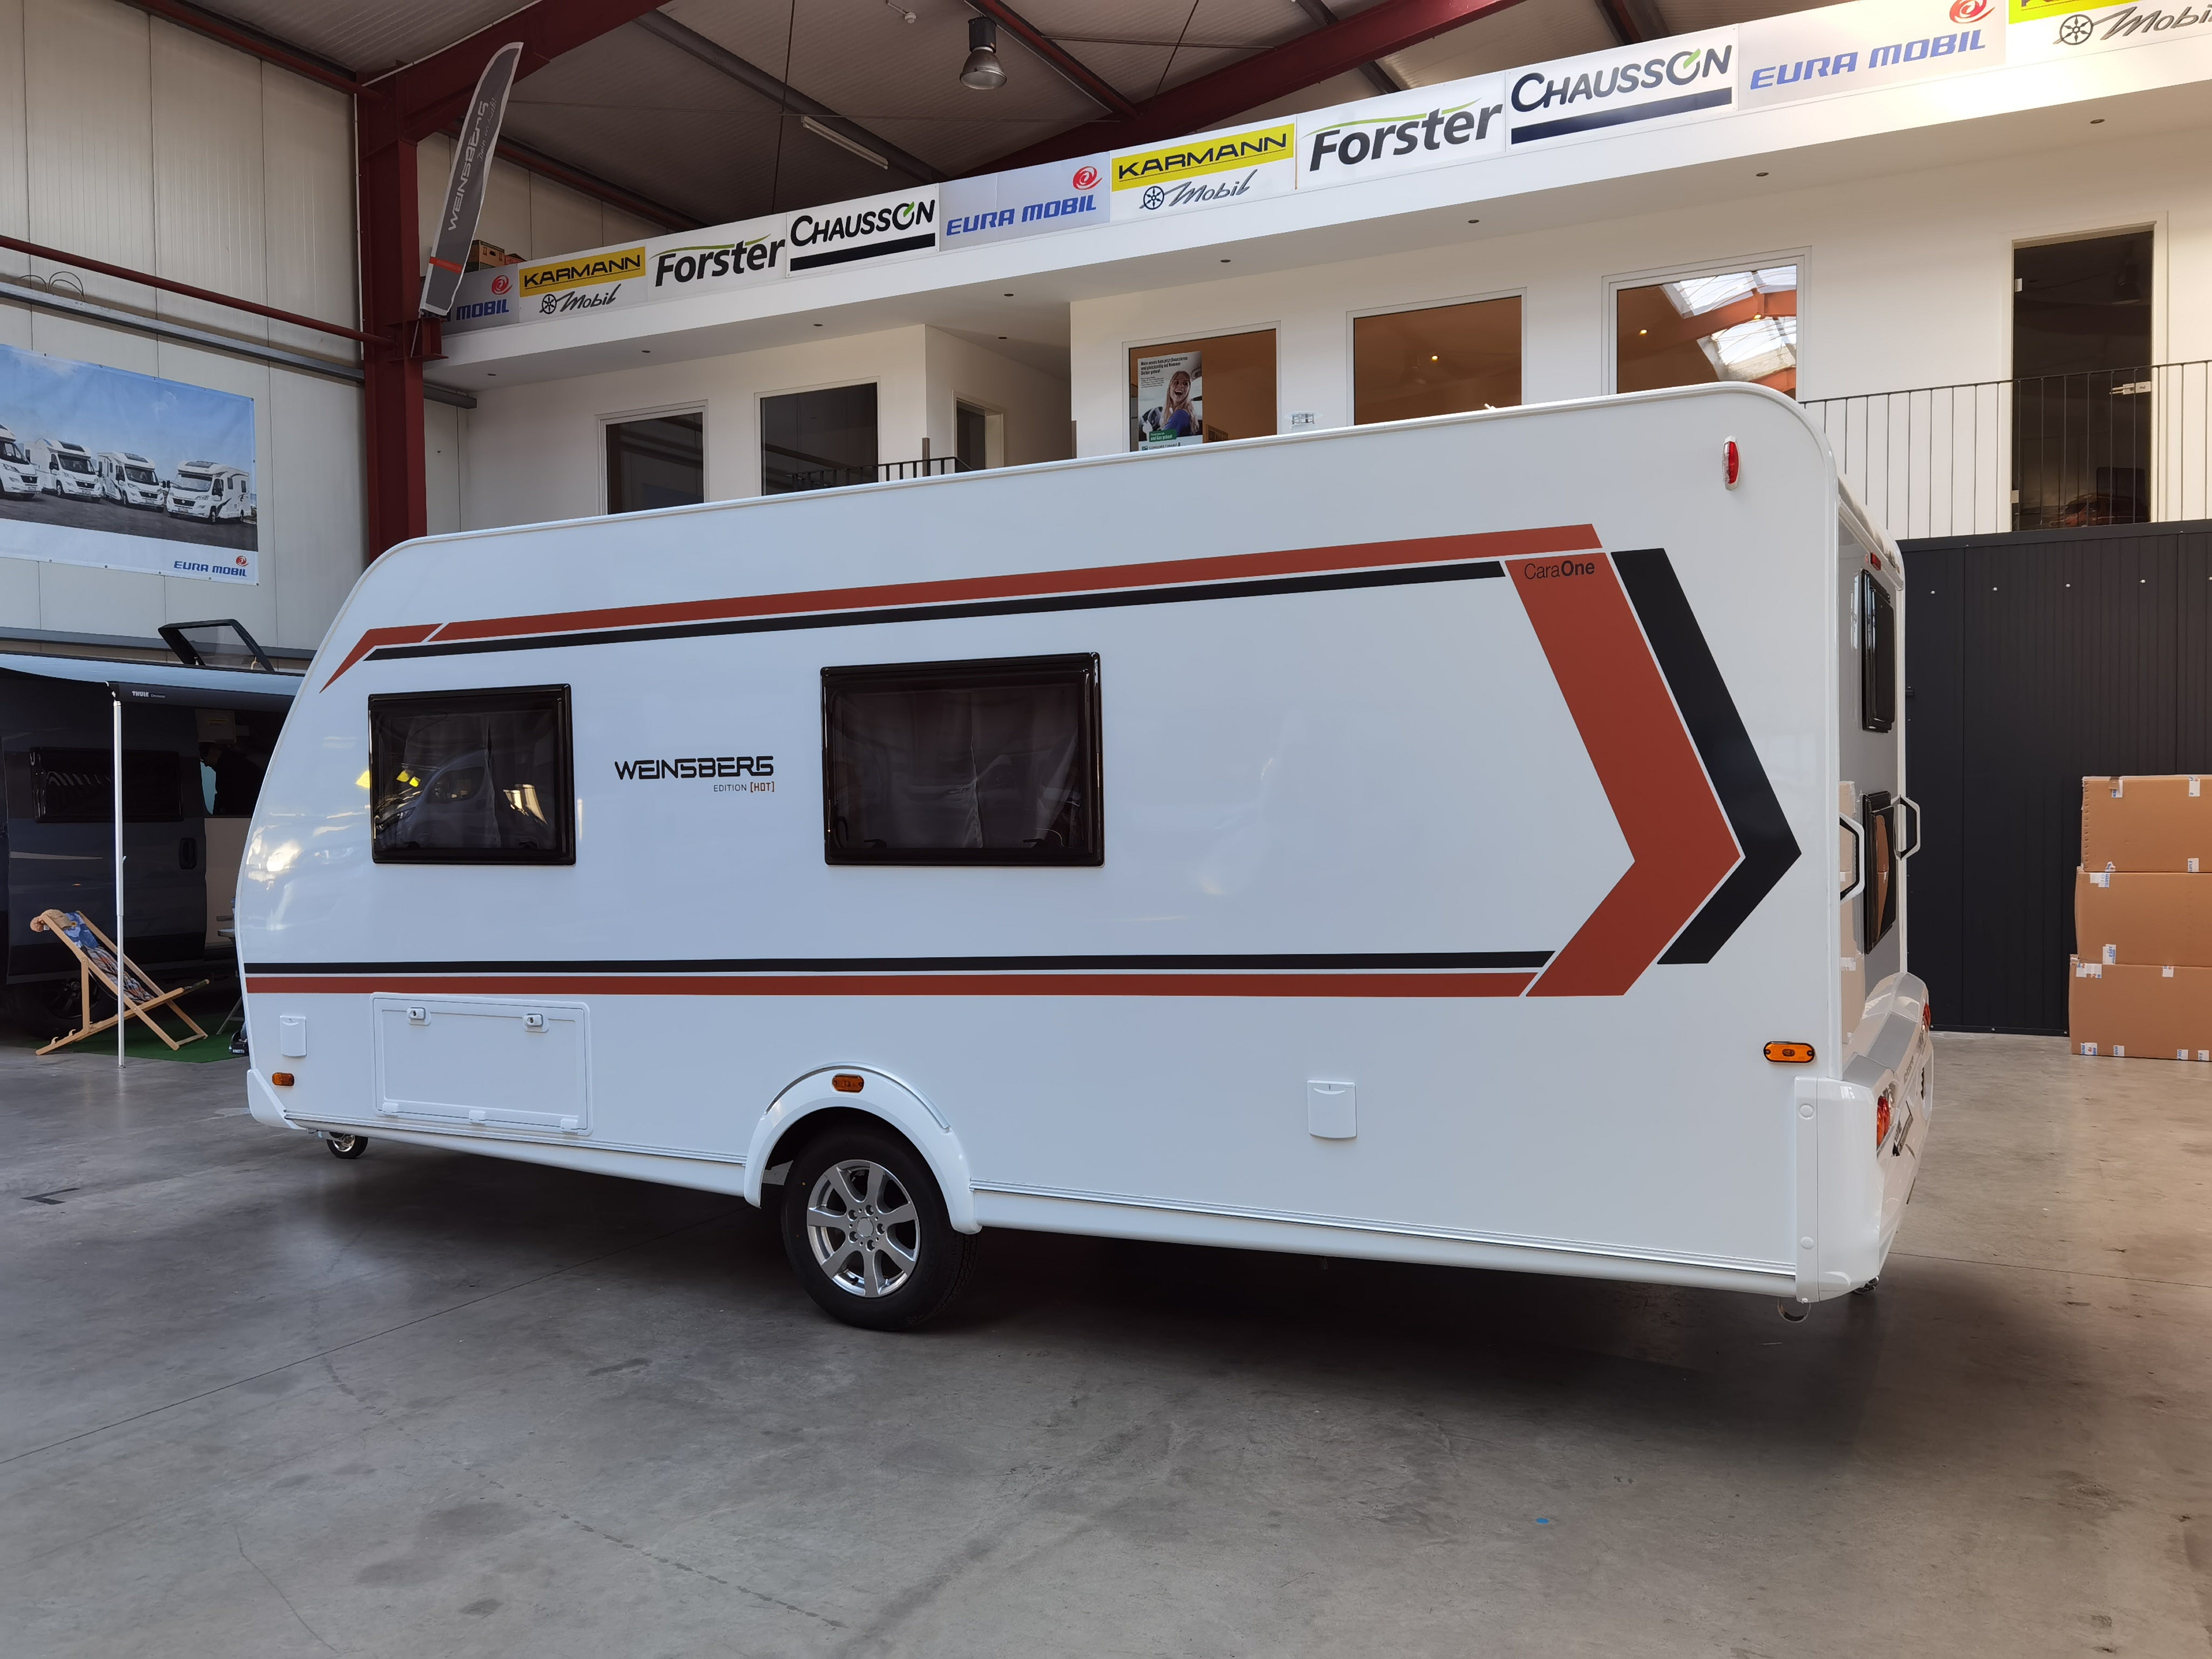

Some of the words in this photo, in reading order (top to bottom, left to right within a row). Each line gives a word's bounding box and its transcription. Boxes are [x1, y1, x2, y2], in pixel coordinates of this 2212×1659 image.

[2093, 4, 2212, 41] Mobi
[1511, 44, 1732, 112] CHAUSSON
[1750, 52, 1858, 90] EURA
[1868, 29, 1986, 69] MOBIL
[1118, 133, 1286, 180] KARMANN
[1310, 103, 1503, 172] Forster
[448, 100, 489, 231] WEINSBERG
[1164, 168, 1258, 207] Mobil
[790, 199, 936, 247] CHAUSSON
[946, 208, 1014, 236] EURA
[1021, 194, 1097, 223] MOBIL
[524, 254, 641, 288] KARMANN
[655, 238, 785, 287] Forster
[456, 299, 510, 321] MOBIL
[556, 282, 622, 312] Mobil
[173, 561, 209, 572] EURA
[212, 565, 247, 577] MOBIL
[1524, 560, 1595, 579] CaraOne
[614, 755, 774, 780] WEINSBERG
[713, 783, 747, 792] EDITION
[750, 781, 775, 793] [HOT]
